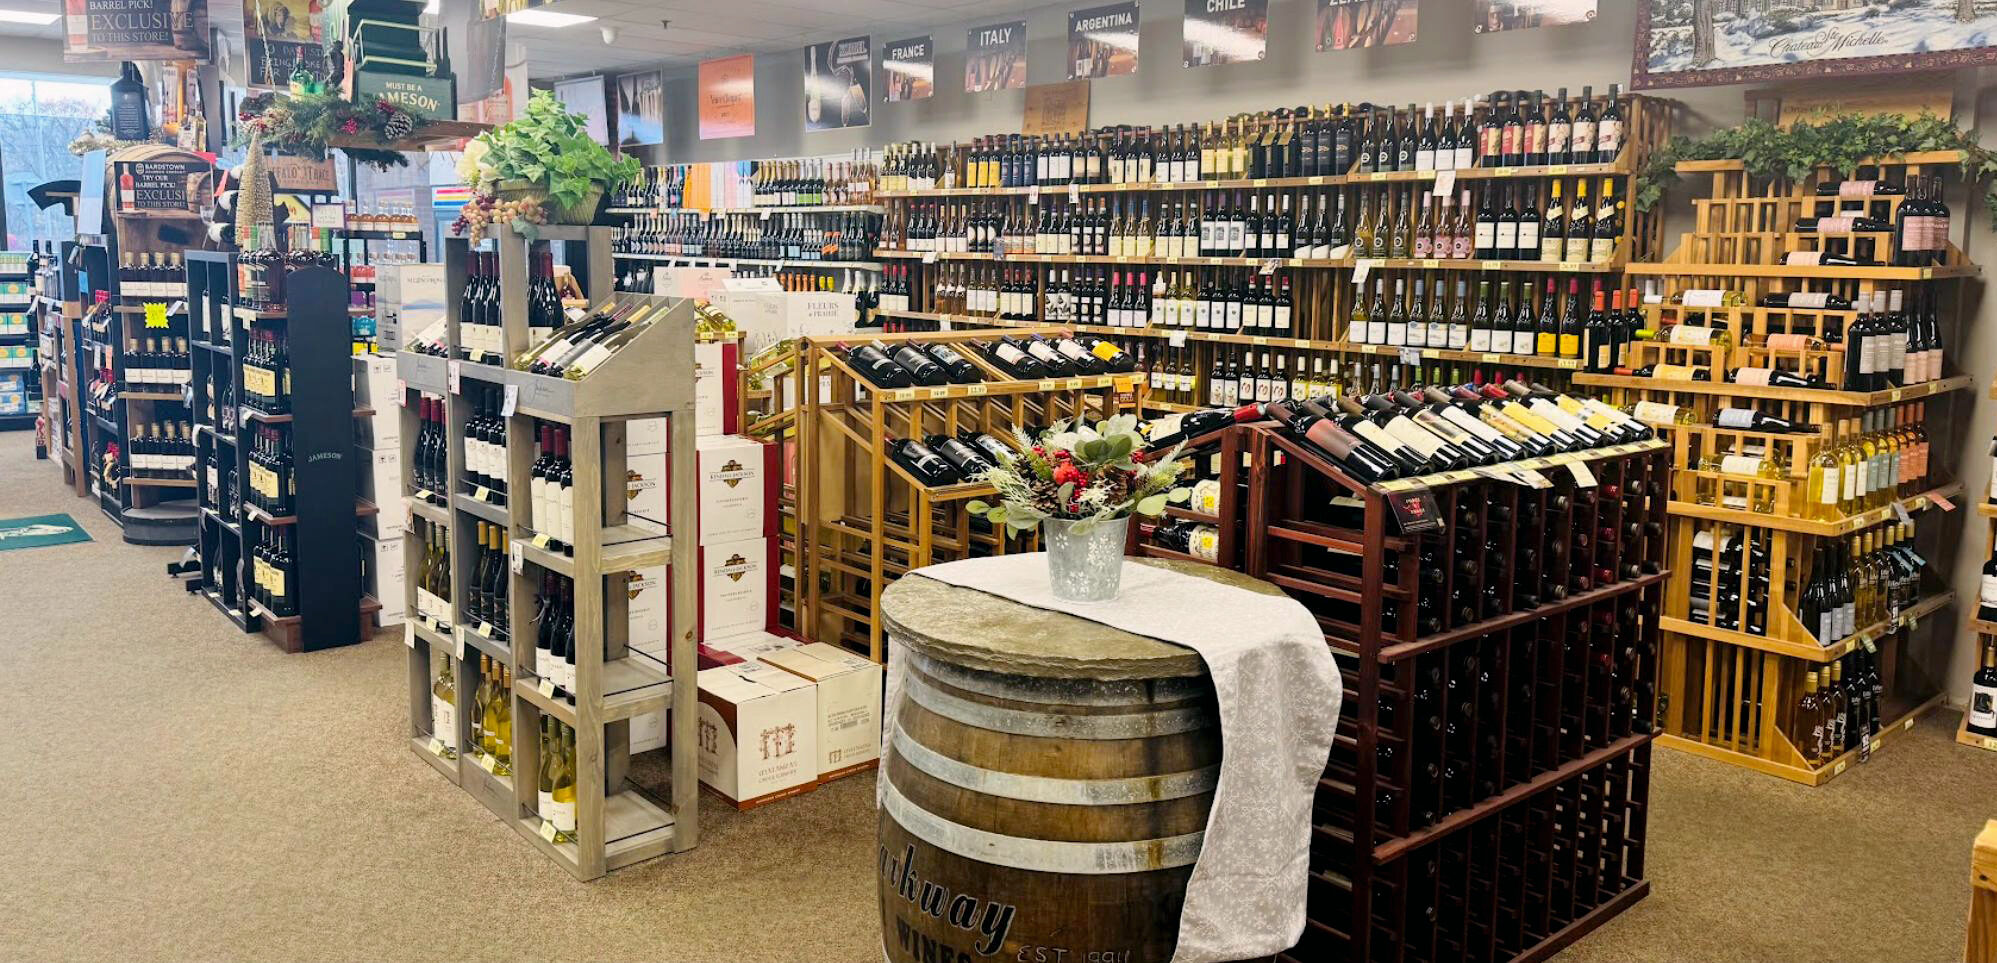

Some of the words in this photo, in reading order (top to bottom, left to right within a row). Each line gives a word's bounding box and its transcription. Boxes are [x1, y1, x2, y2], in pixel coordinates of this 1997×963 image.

[90, 1, 126, 10] BARREL
[128, 0, 153, 9] PICK!
[1206, 0, 1246, 13] CHILE
[91, 12, 194, 30] EXCLUSIVE
[1075, 12, 1133, 33] ARGENTINA
[108, 32, 129, 42] THIS
[132, 31, 169, 41] STORE!
[980, 28, 1012, 46] ITALY
[1769, 38, 1824, 58] Chateau
[1832, 30, 1884, 52] Michelle
[892, 44, 925, 60] FRANCE
[385, 82, 404, 90] MUST
[379, 92, 437, 112] AMESON
[880, 843, 1016, 957] arkway
